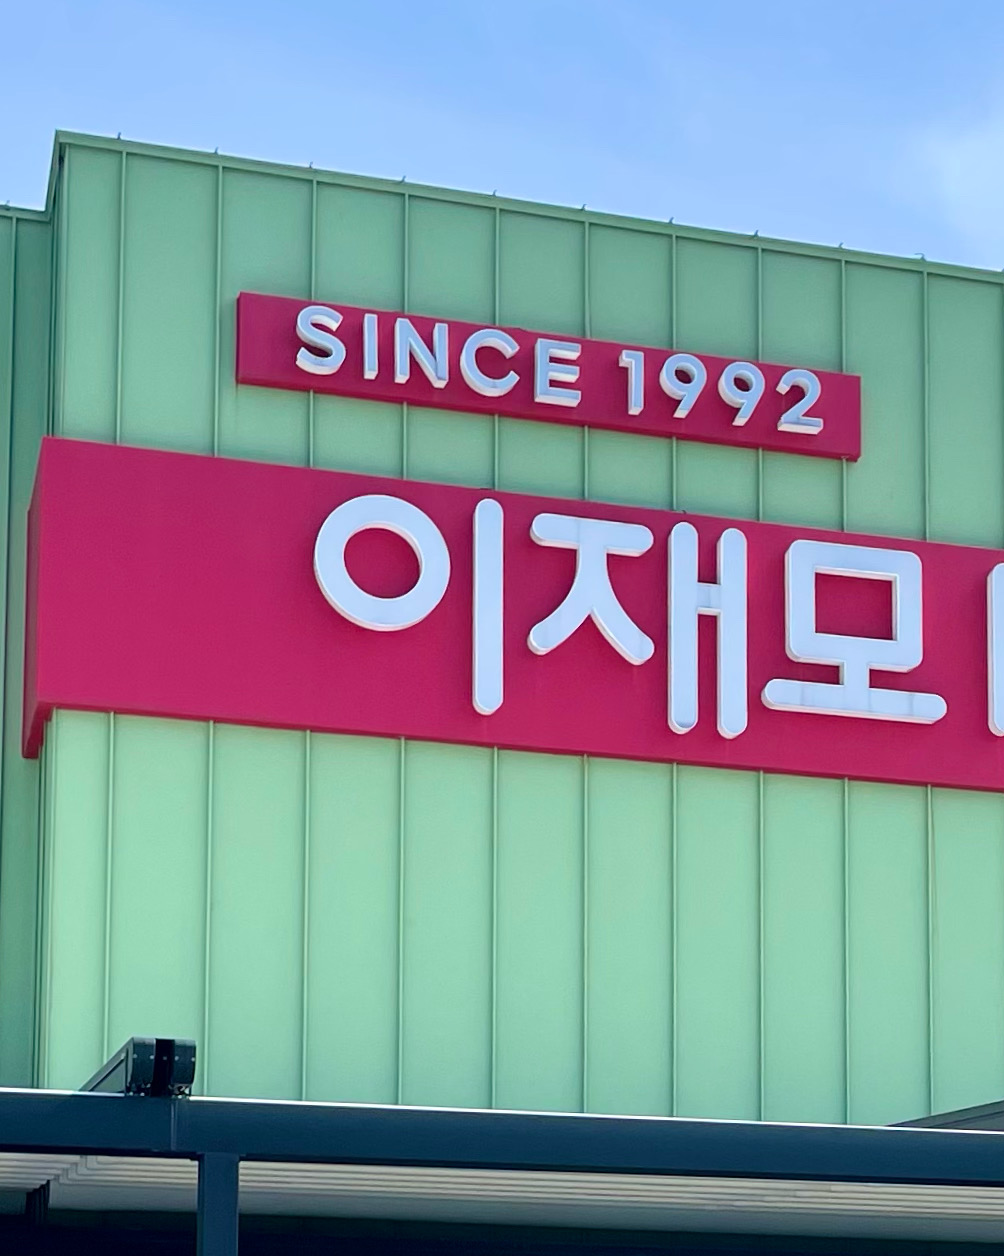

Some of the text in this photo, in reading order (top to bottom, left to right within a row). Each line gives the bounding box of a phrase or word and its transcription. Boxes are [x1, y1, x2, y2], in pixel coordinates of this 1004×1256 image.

[295, 305, 825, 435] SINCE 1992
[313, 493, 949, 740] 이재모
